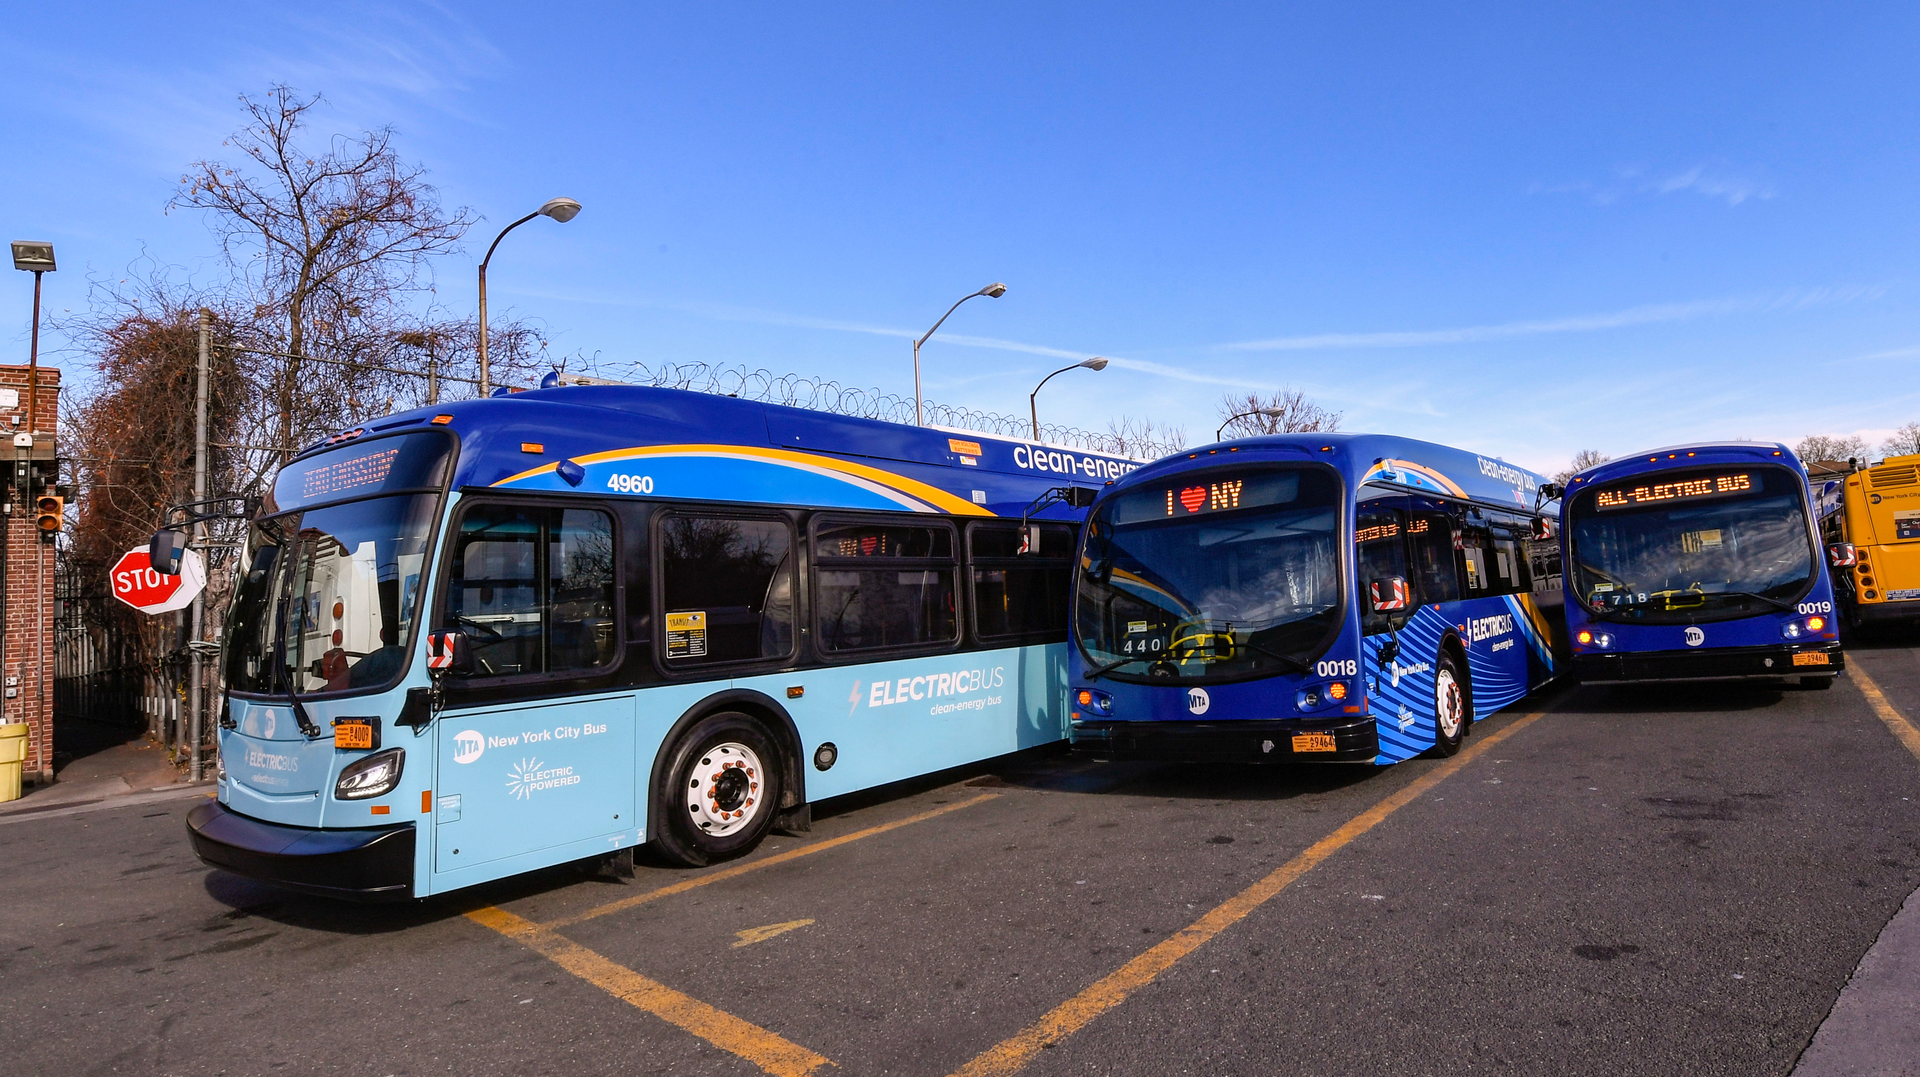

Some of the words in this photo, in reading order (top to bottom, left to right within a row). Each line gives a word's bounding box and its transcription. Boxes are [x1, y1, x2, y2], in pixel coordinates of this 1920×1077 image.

[607, 473, 654, 494] 4960
[1598, 479, 1713, 507] ALL-ELECTRIC
[1716, 474, 1751, 493] BUS
[1167, 489, 1173, 516] I
[1211, 480, 1243, 510] NY
[1797, 601, 1832, 615] 0019
[1317, 659, 1357, 677] 0018
[868, 666, 1004, 708] ELECTRICBUS
[930, 698, 986, 716] clean-energy
[987, 695, 1002, 706] bus
[488, 735, 519, 749] New
[522, 729, 551, 744] York
[554, 724, 581, 740] City
[583, 723, 607, 736] Bus
[250, 751, 299, 772] ELECTRICBUS
[523, 766, 573, 783] ELECTRIC
[530, 775, 581, 792] POWERED
